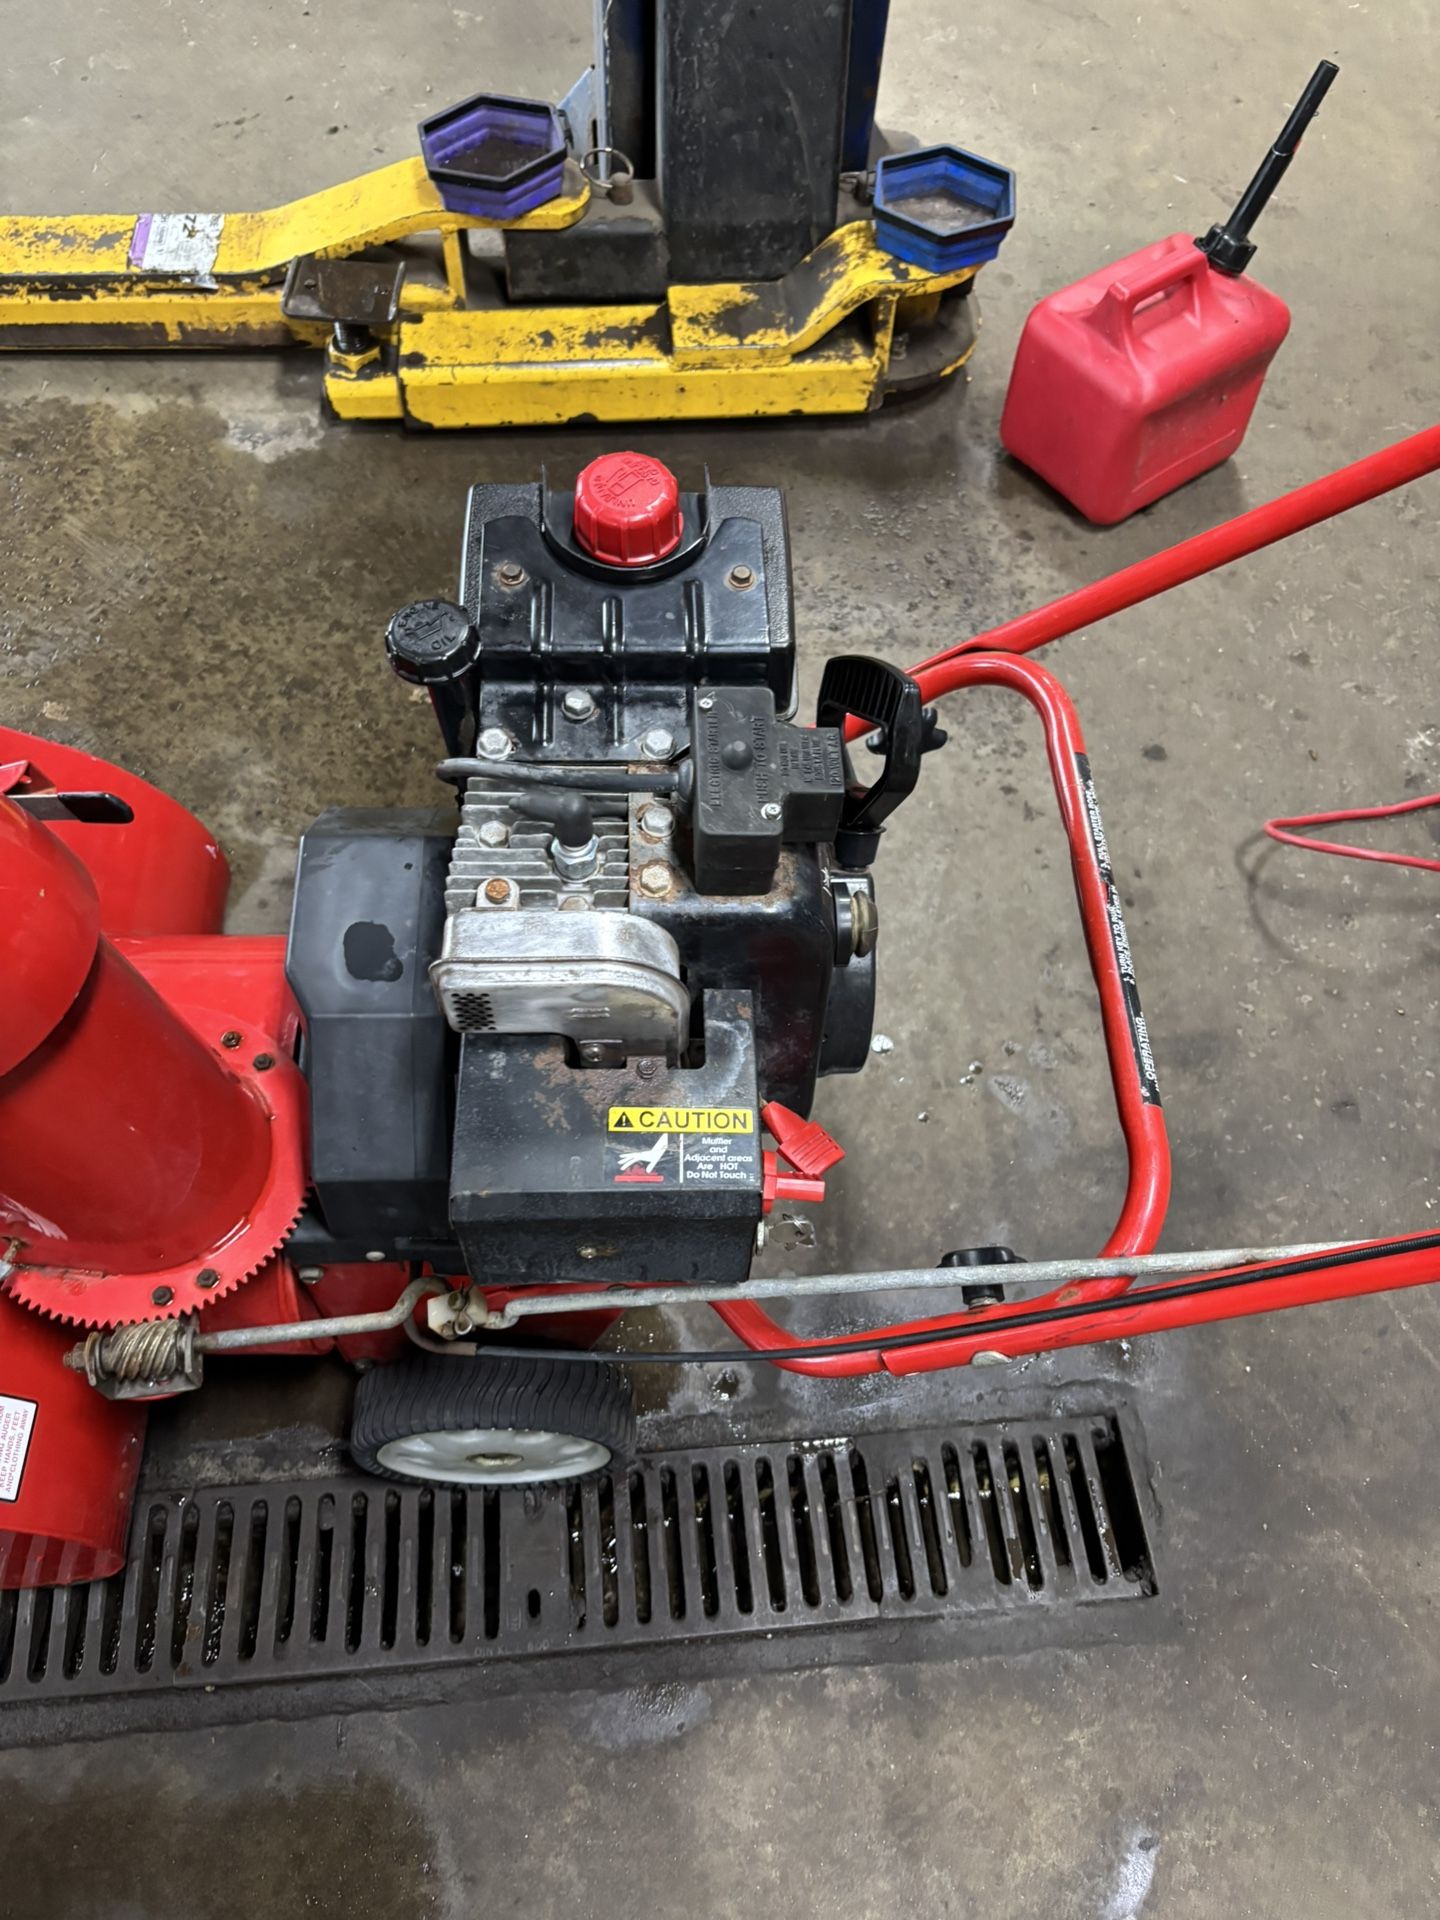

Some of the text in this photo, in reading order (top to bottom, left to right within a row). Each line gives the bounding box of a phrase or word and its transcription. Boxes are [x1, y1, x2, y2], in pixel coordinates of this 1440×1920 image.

[431, 634, 457, 651] OIL
[751, 716, 768, 804] PUSH TO START
[1115, 936, 1125, 951] KEY
[1118, 952, 1128, 974] TURN
[1135, 1016, 1155, 1081] OPERATING
[639, 1111, 747, 1129] CAUTION
[701, 1137, 732, 1145] Muffler
[684, 1154, 726, 1162] Adjacent
[686, 1171, 700, 1179] Do
[701, 1171, 717, 1179] Not
[719, 1171, 747, 1179] Touch
[11, 1410, 21, 1431] FEET
[6, 1408, 29, 1493] AND CLOTHING AWAY
